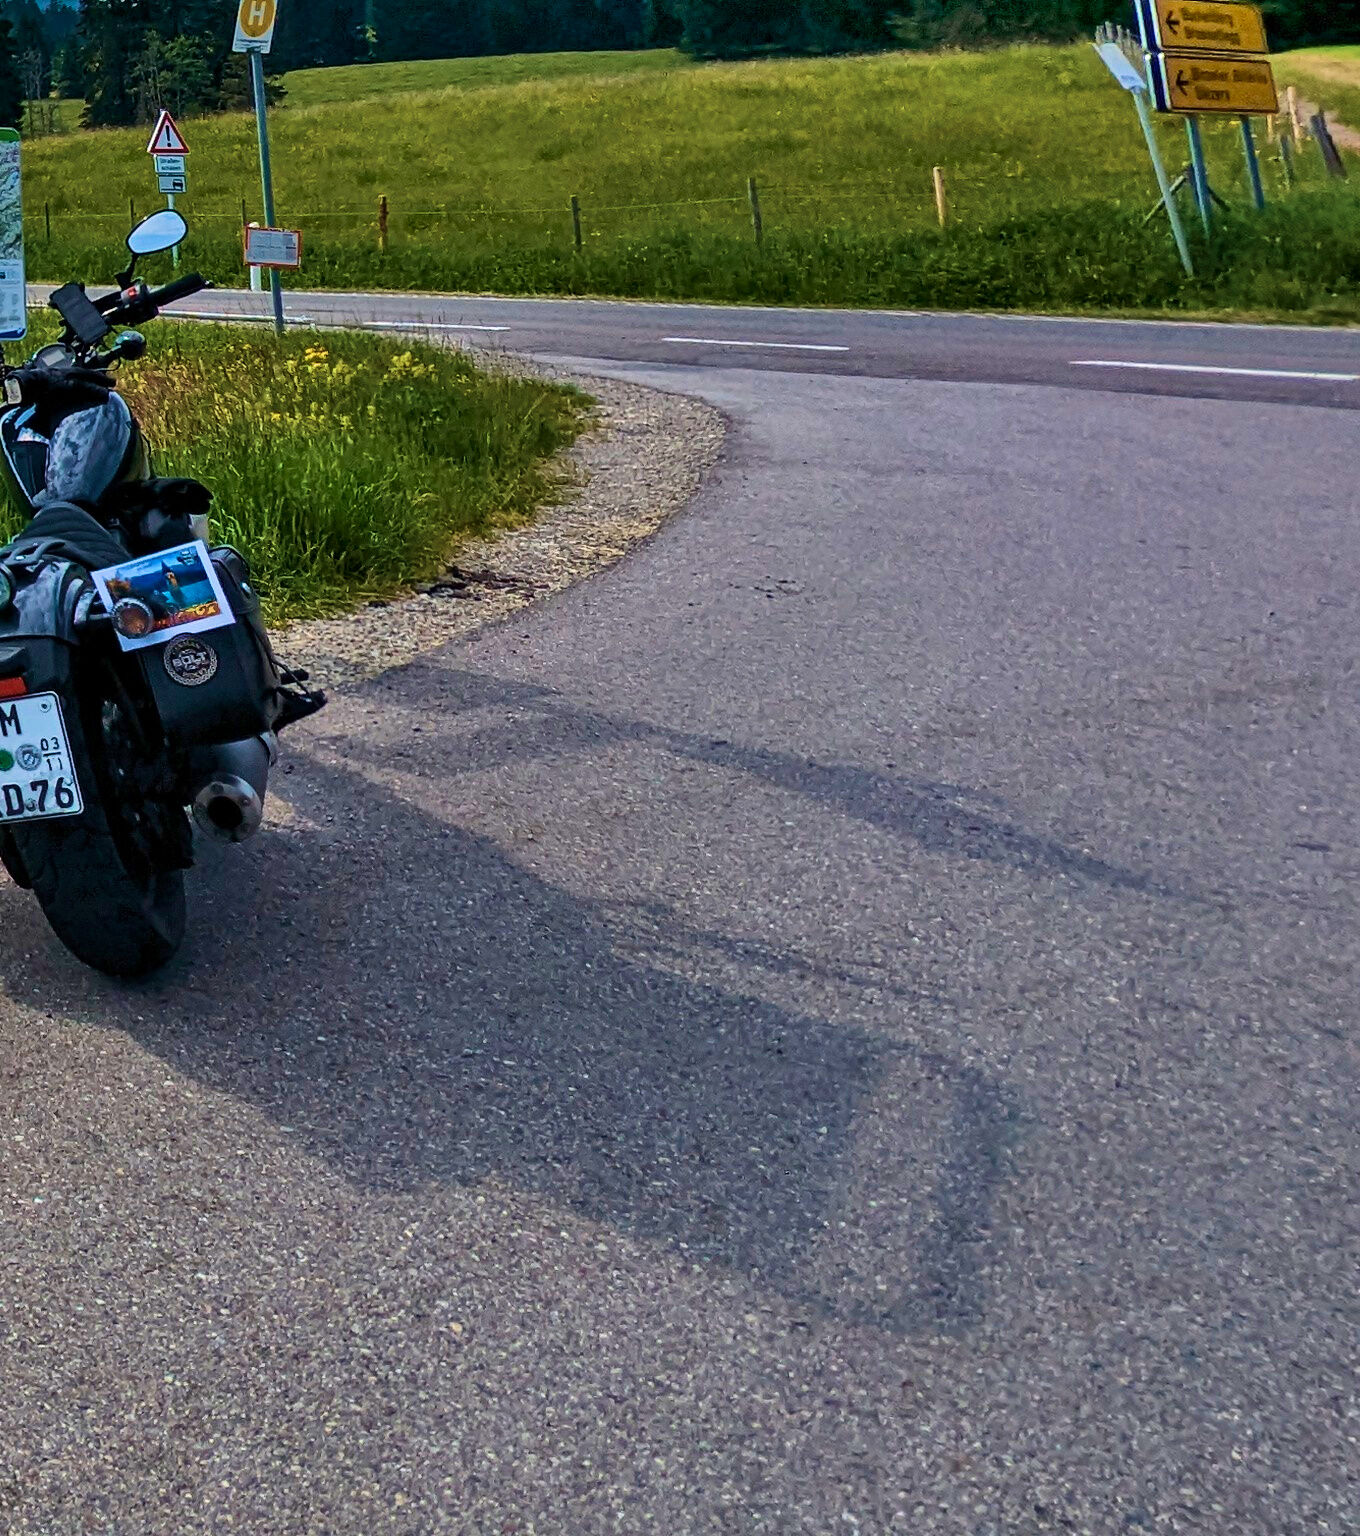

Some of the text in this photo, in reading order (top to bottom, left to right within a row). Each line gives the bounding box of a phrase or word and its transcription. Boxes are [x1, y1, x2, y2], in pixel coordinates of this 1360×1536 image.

[248, 0, 266, 26] H
[40, 736, 60, 751] 03
[29, 776, 75, 812] 76
